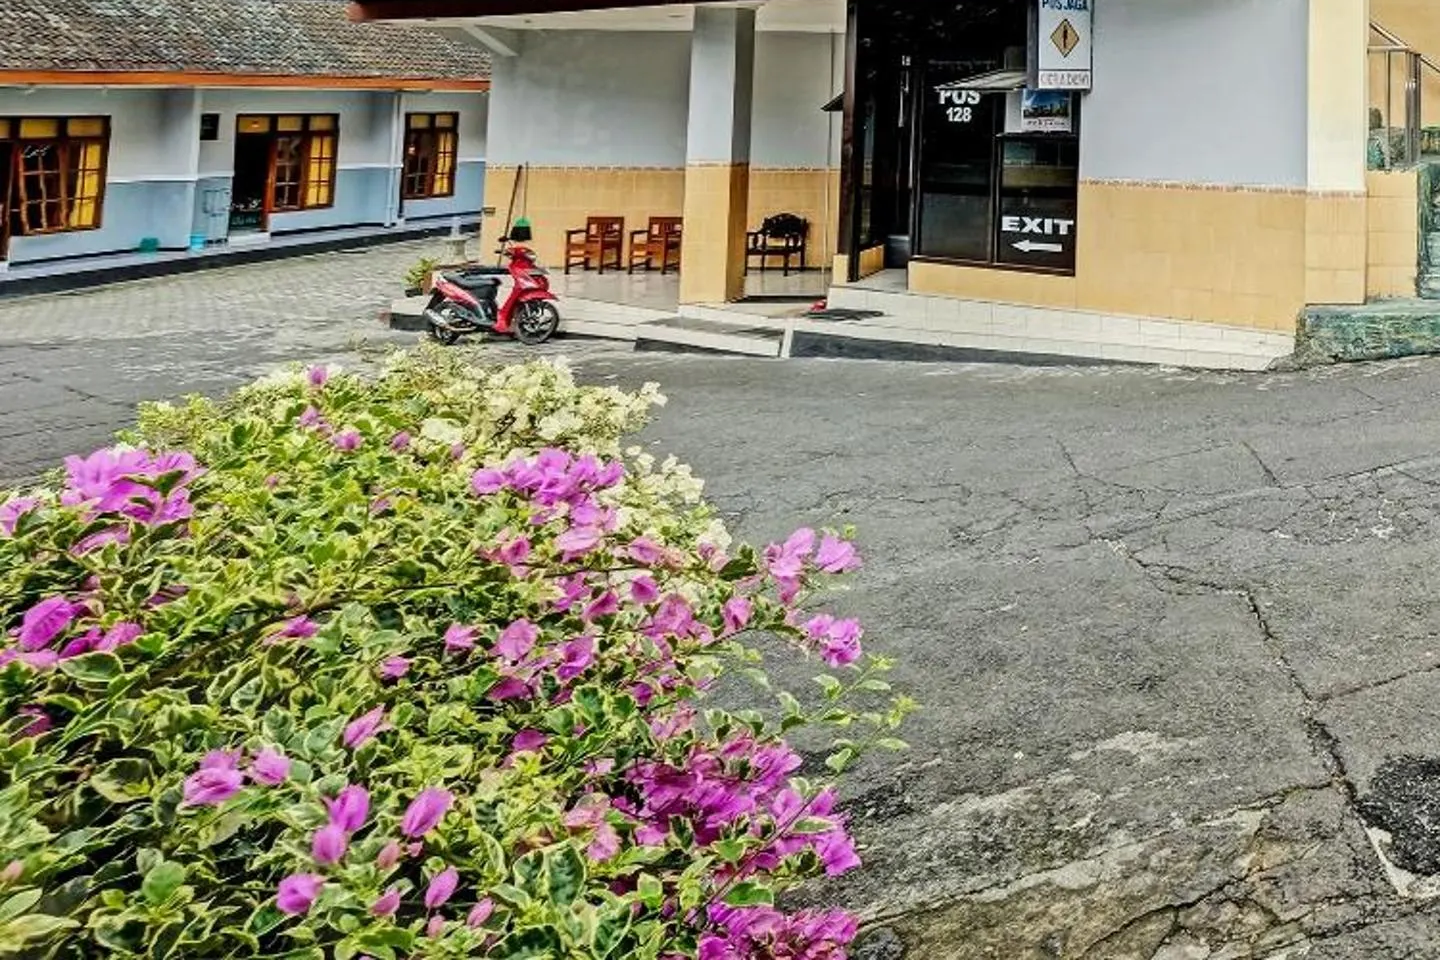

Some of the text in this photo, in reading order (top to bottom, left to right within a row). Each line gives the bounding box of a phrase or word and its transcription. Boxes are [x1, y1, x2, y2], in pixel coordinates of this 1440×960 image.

[938, 89, 980, 105] POS
[946, 107, 972, 122] 128
[1002, 216, 1074, 235] EXIT
